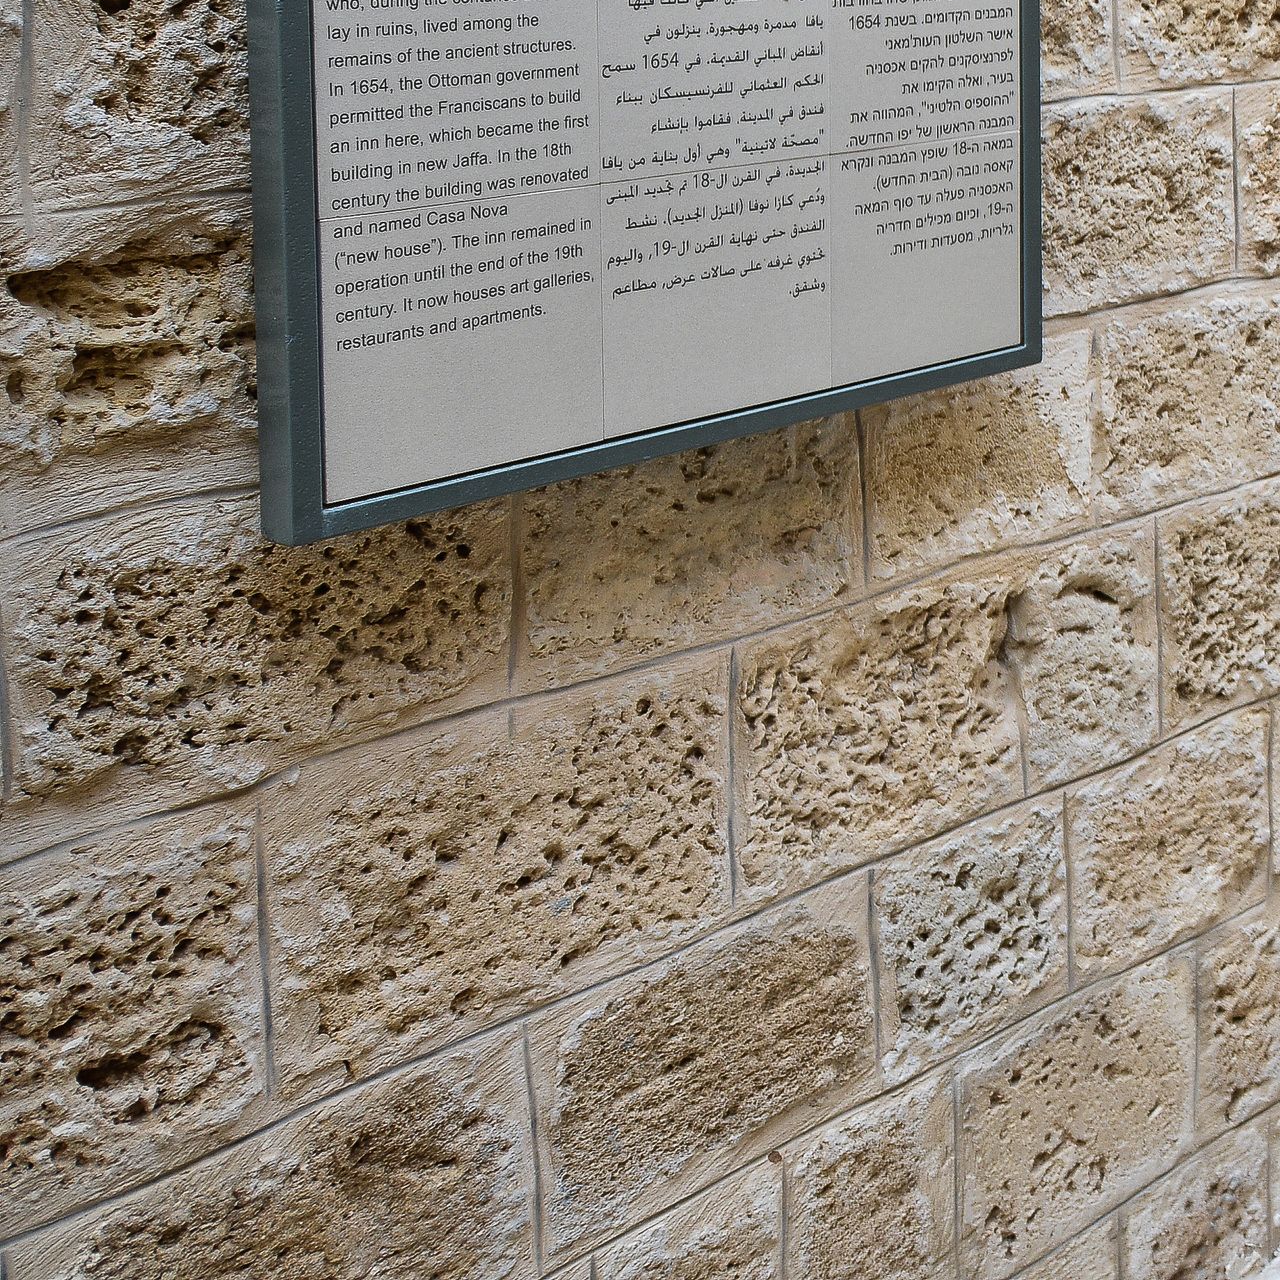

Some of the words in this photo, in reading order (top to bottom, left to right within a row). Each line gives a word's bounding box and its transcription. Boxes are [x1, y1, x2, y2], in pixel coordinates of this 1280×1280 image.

[328, 25, 350, 42] lay
[357, 24, 369, 37] in
[376, 22, 417, 38] ruins,
[424, 18, 457, 33] lived
[463, 18, 511, 31] among
[517, 14, 538, 27] the
[329, 51, 392, 68] remains
[397, 48, 413, 63] of
[416, 48, 440, 61] the
[446, 43, 499, 59] ancient
[504, 40, 576, 55] structures.
[911, 55, 944, 73] להקים
[949, 48, 1013, 68] לפרנציסקנים
[866, 61, 905, 75] אכסניה
[330, 83, 343, 96] In
[351, 78, 393, 94] 1654,
[398, 77, 422, 90] the
[429, 73, 491, 88] Ottoman
[497, 63, 579, 86] government
[740, 77, 786, 98] العثماني
[794, 73, 823, 92] الحكم
[616, 91, 642, 105] ببناء
[650, 82, 733, 104] للفرنسيسكان
[330, 105, 403, 129] permitted
[408, 104, 432, 117] the
[439, 97, 527, 115] Franciscans
[531, 93, 543, 106] to
[549, 89, 580, 104] build
[937, 121, 975, 139] הראשון
[979, 116, 1014, 130] המבנה
[330, 142, 349, 153] an
[356, 137, 379, 151] inn
[385, 134, 423, 148] here,
[429, 126, 471, 143] which
[477, 123, 533, 138] became
[538, 118, 559, 131] the
[563, 115, 589, 129] first
[846, 132, 893, 147] החדשה.
[898, 129, 911, 141] יפו
[916, 125, 932, 143] של
[331, 164, 392, 182] building
[399, 161, 411, 174] in
[417, 159, 447, 172] new
[453, 152, 492, 168] Jaffa.
[498, 149, 510, 163] In
[516, 147, 537, 161] the
[543, 143, 571, 157] 18th
[332, 193, 390, 210] century
[395, 188, 419, 202] the
[425, 181, 482, 200] building
[487, 178, 515, 190] was
[521, 166, 588, 186] renovated
[334, 221, 362, 238] and
[369, 213, 421, 234] named
[427, 211, 465, 225] Casa
[471, 205, 507, 219] Nova
[978, 223, 1013, 241] גלריות,
[451, 235, 479, 249] The
[485, 231, 505, 244] inn
[512, 219, 575, 241] remained
[581, 220, 591, 230] in
[931, 231, 973, 248] מסעדות
[890, 239, 926, 255] ודירות.
[335, 273, 408, 297] operation
[415, 265, 444, 282] until
[450, 263, 472, 277] the
[478, 256, 504, 272] end
[510, 254, 524, 268] of
[527, 248, 549, 265] the
[554, 243, 583, 262] 19th
[336, 304, 397, 323] century.
[404, 298, 413, 312] It
[418, 295, 448, 309] now
[454, 286, 505, 303] houses
[510, 279, 529, 294] art
[534, 271, 594, 293] galleries,
[337, 325, 424, 352] restaurants
[430, 317, 456, 334] and
[462, 305, 546, 331] apartments.
